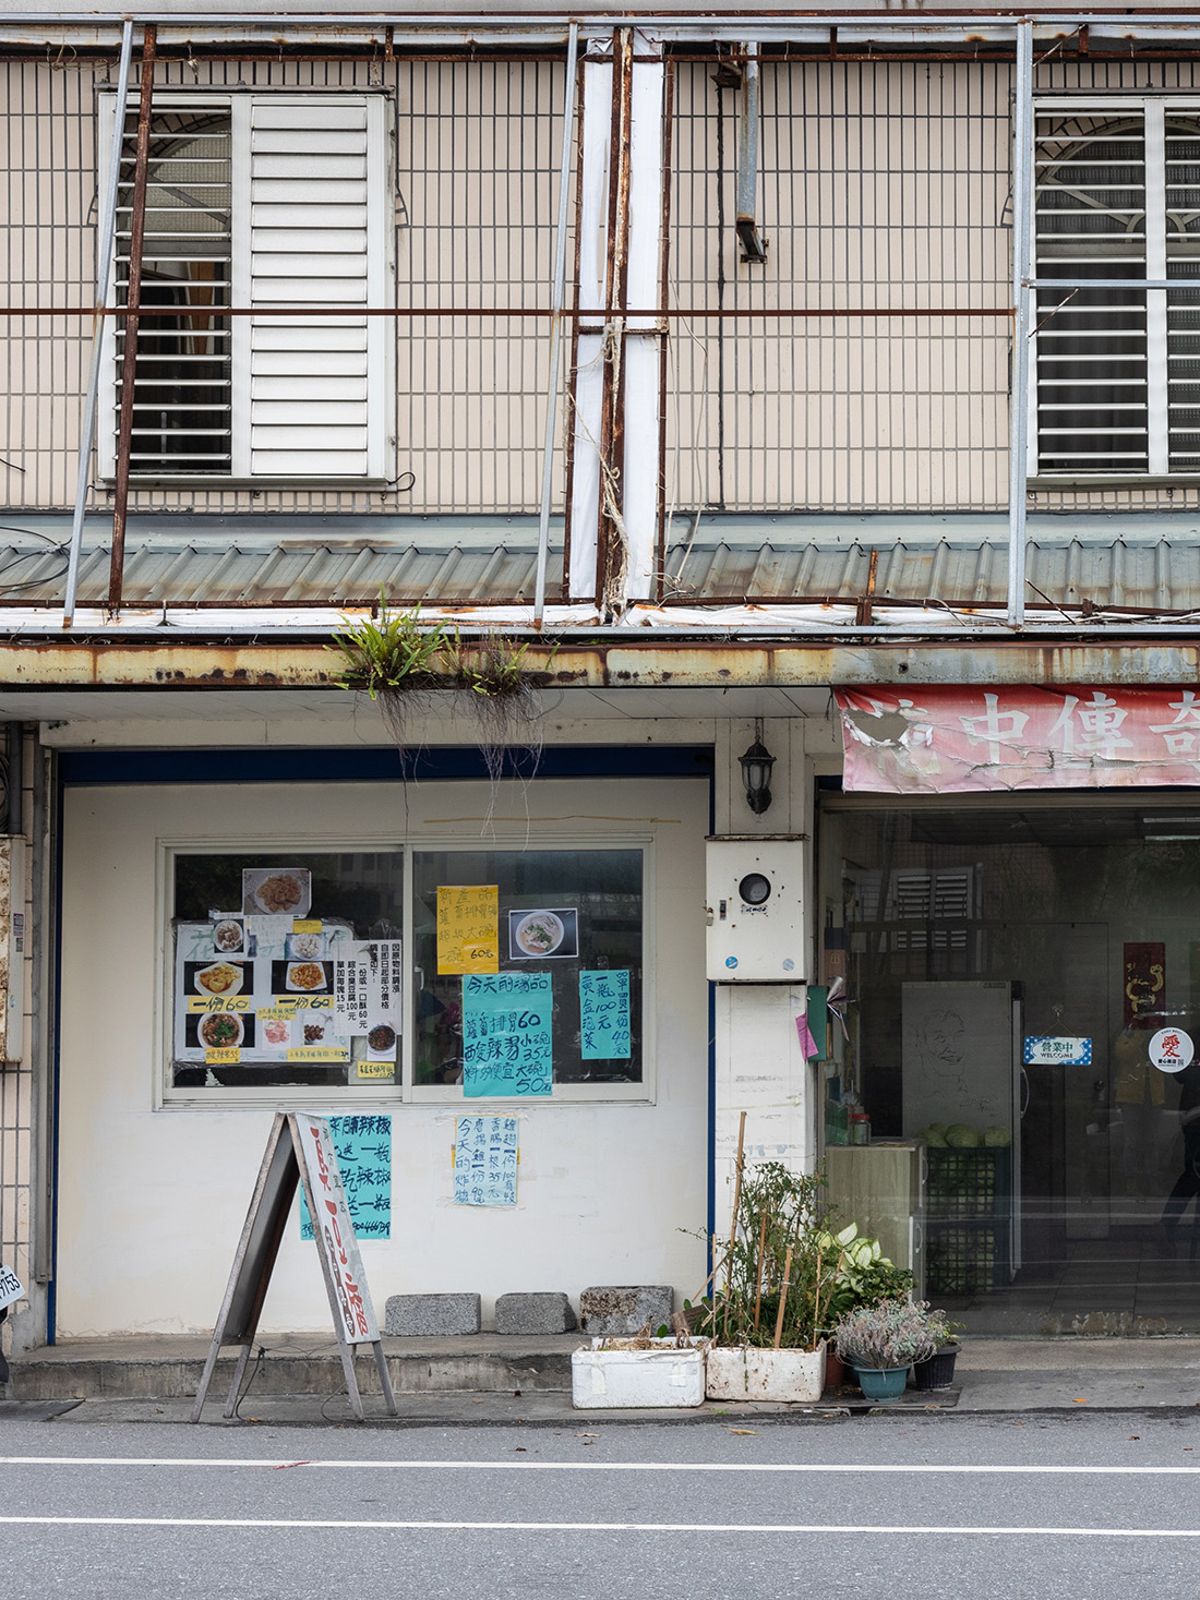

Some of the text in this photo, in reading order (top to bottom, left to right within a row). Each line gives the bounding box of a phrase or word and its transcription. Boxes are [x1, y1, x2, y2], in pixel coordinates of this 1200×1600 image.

[346, 961, 358, 1021] 綜合臭豆腐100元
[380, 943, 390, 1010] 自即日起部分價格
[467, 975, 549, 995] 今天的湯品
[595, 974, 617, 1031] 一瓶100元
[582, 975, 598, 1050] 黃金泡菜
[1041, 1041, 1073, 1053] 營業中
[1162, 1034, 1181, 1058] 愛
